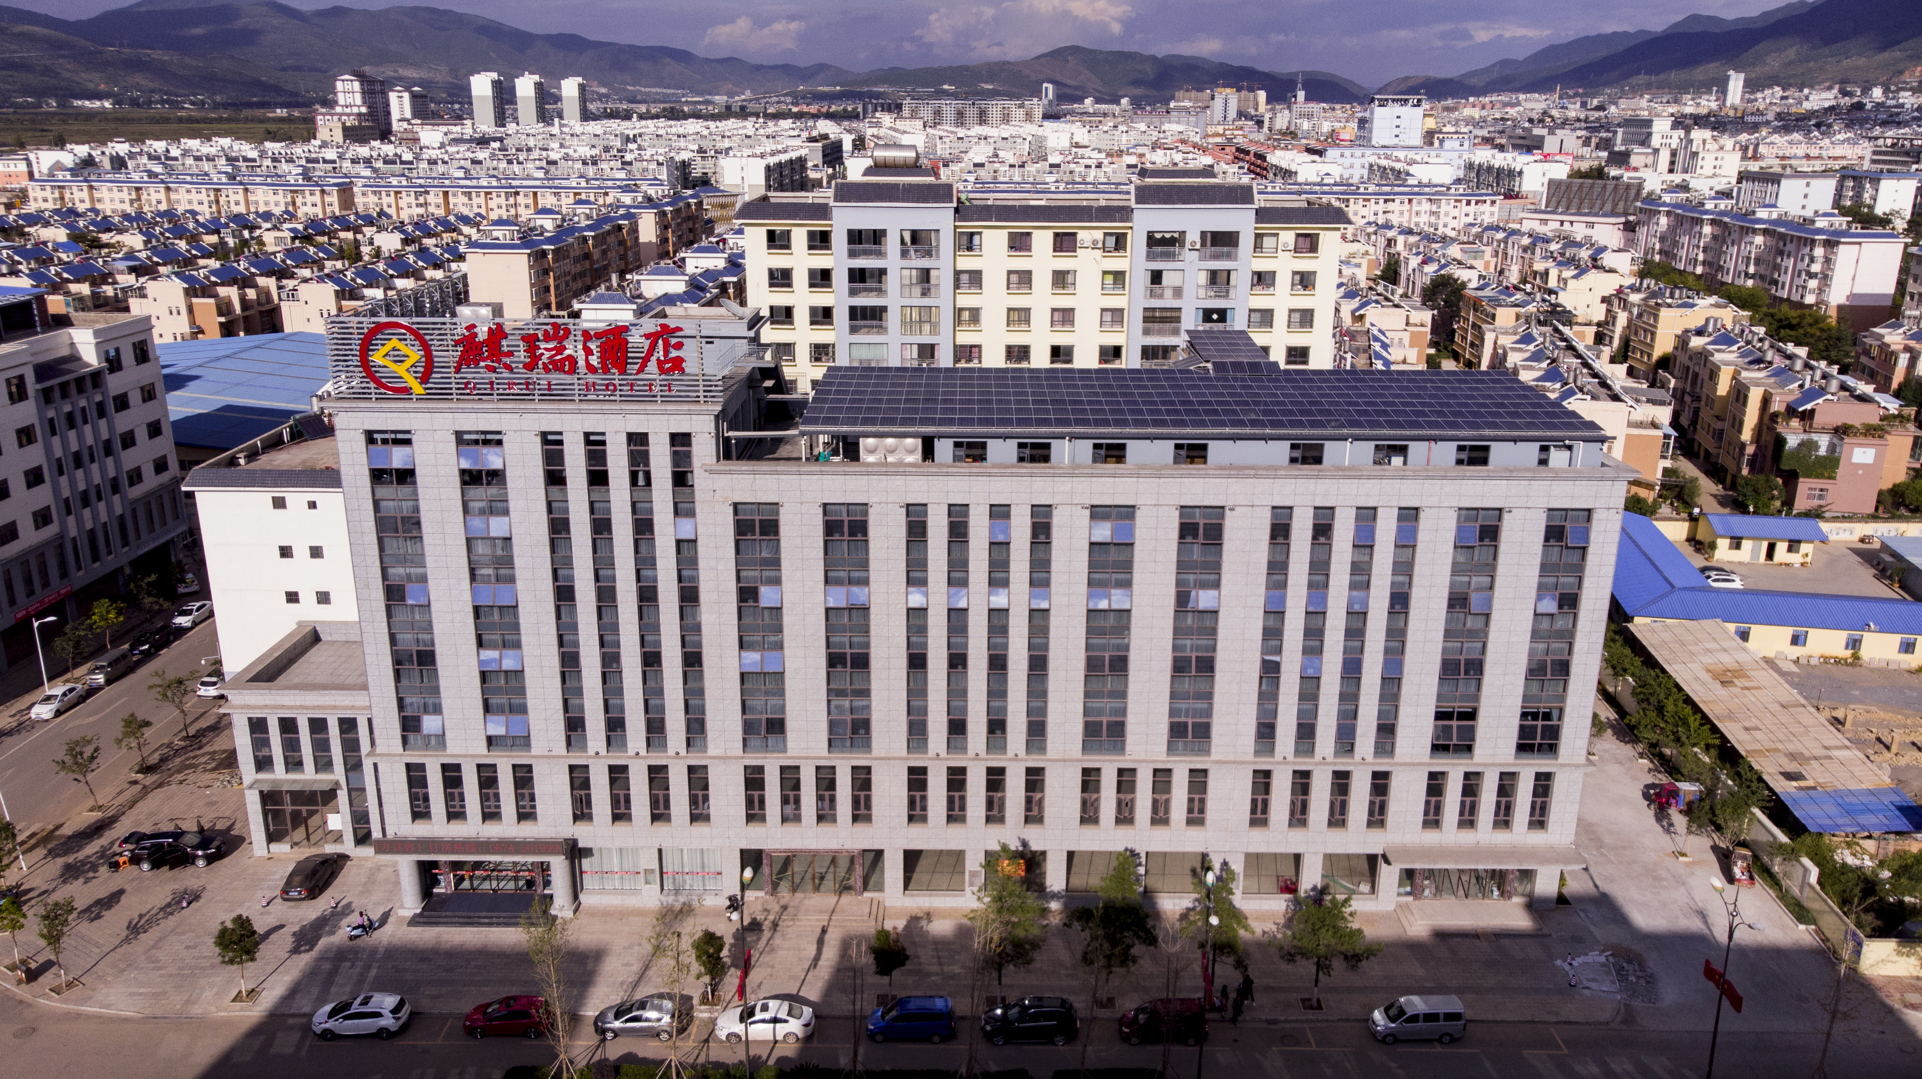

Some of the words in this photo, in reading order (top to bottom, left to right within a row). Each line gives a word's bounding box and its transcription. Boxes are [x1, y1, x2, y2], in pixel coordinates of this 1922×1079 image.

[454, 322, 685, 375] 麒瑞酒店
[464, 380, 553, 394] QIRUI
[584, 381, 677, 394] HOTEL
